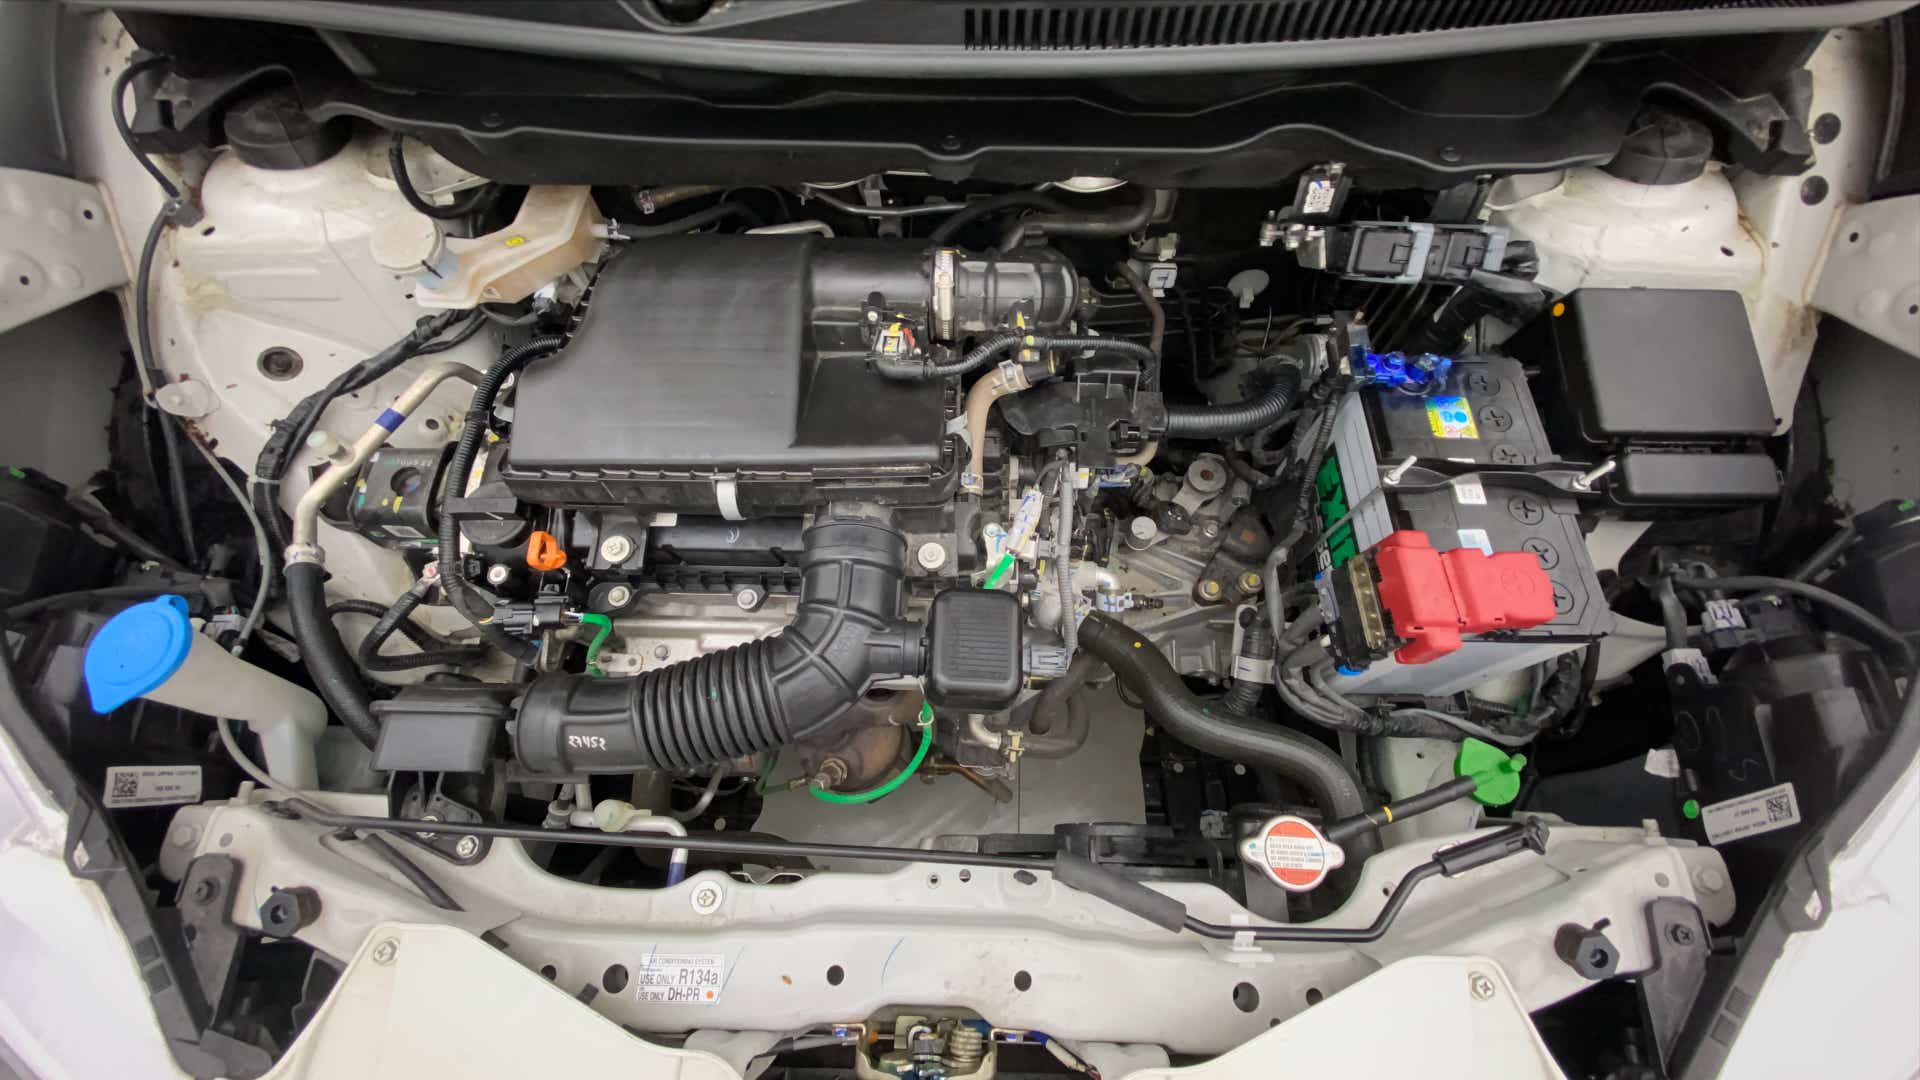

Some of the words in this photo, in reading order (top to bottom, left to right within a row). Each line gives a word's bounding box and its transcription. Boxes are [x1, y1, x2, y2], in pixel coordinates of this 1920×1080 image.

[639, 974, 654, 985] USE
[656, 974, 675, 985] ONLY
[679, 968, 719, 985] R134a
[638, 991, 649, 1001] USE
[650, 991, 664, 1001] ONLY
[667, 987, 700, 1001] DH-PR
